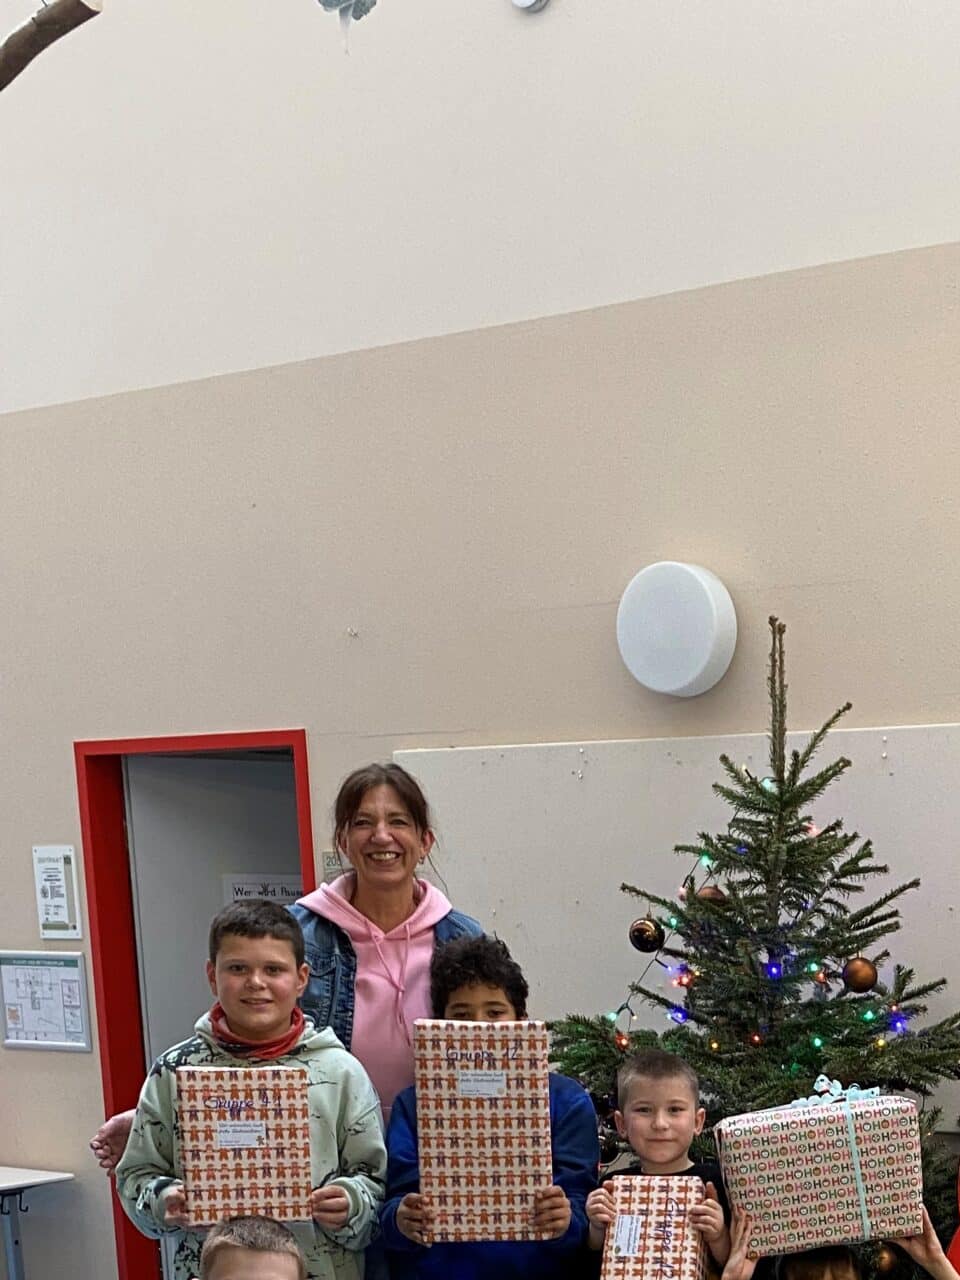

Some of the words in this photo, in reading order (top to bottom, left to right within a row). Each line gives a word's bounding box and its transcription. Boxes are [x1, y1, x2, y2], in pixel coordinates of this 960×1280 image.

[233, 887, 251, 897] Wer
[446, 1047, 495, 1067] Gruppe
[203, 1096, 255, 1115] Gruppe
[648, 1198, 680, 1253] Gruppe
